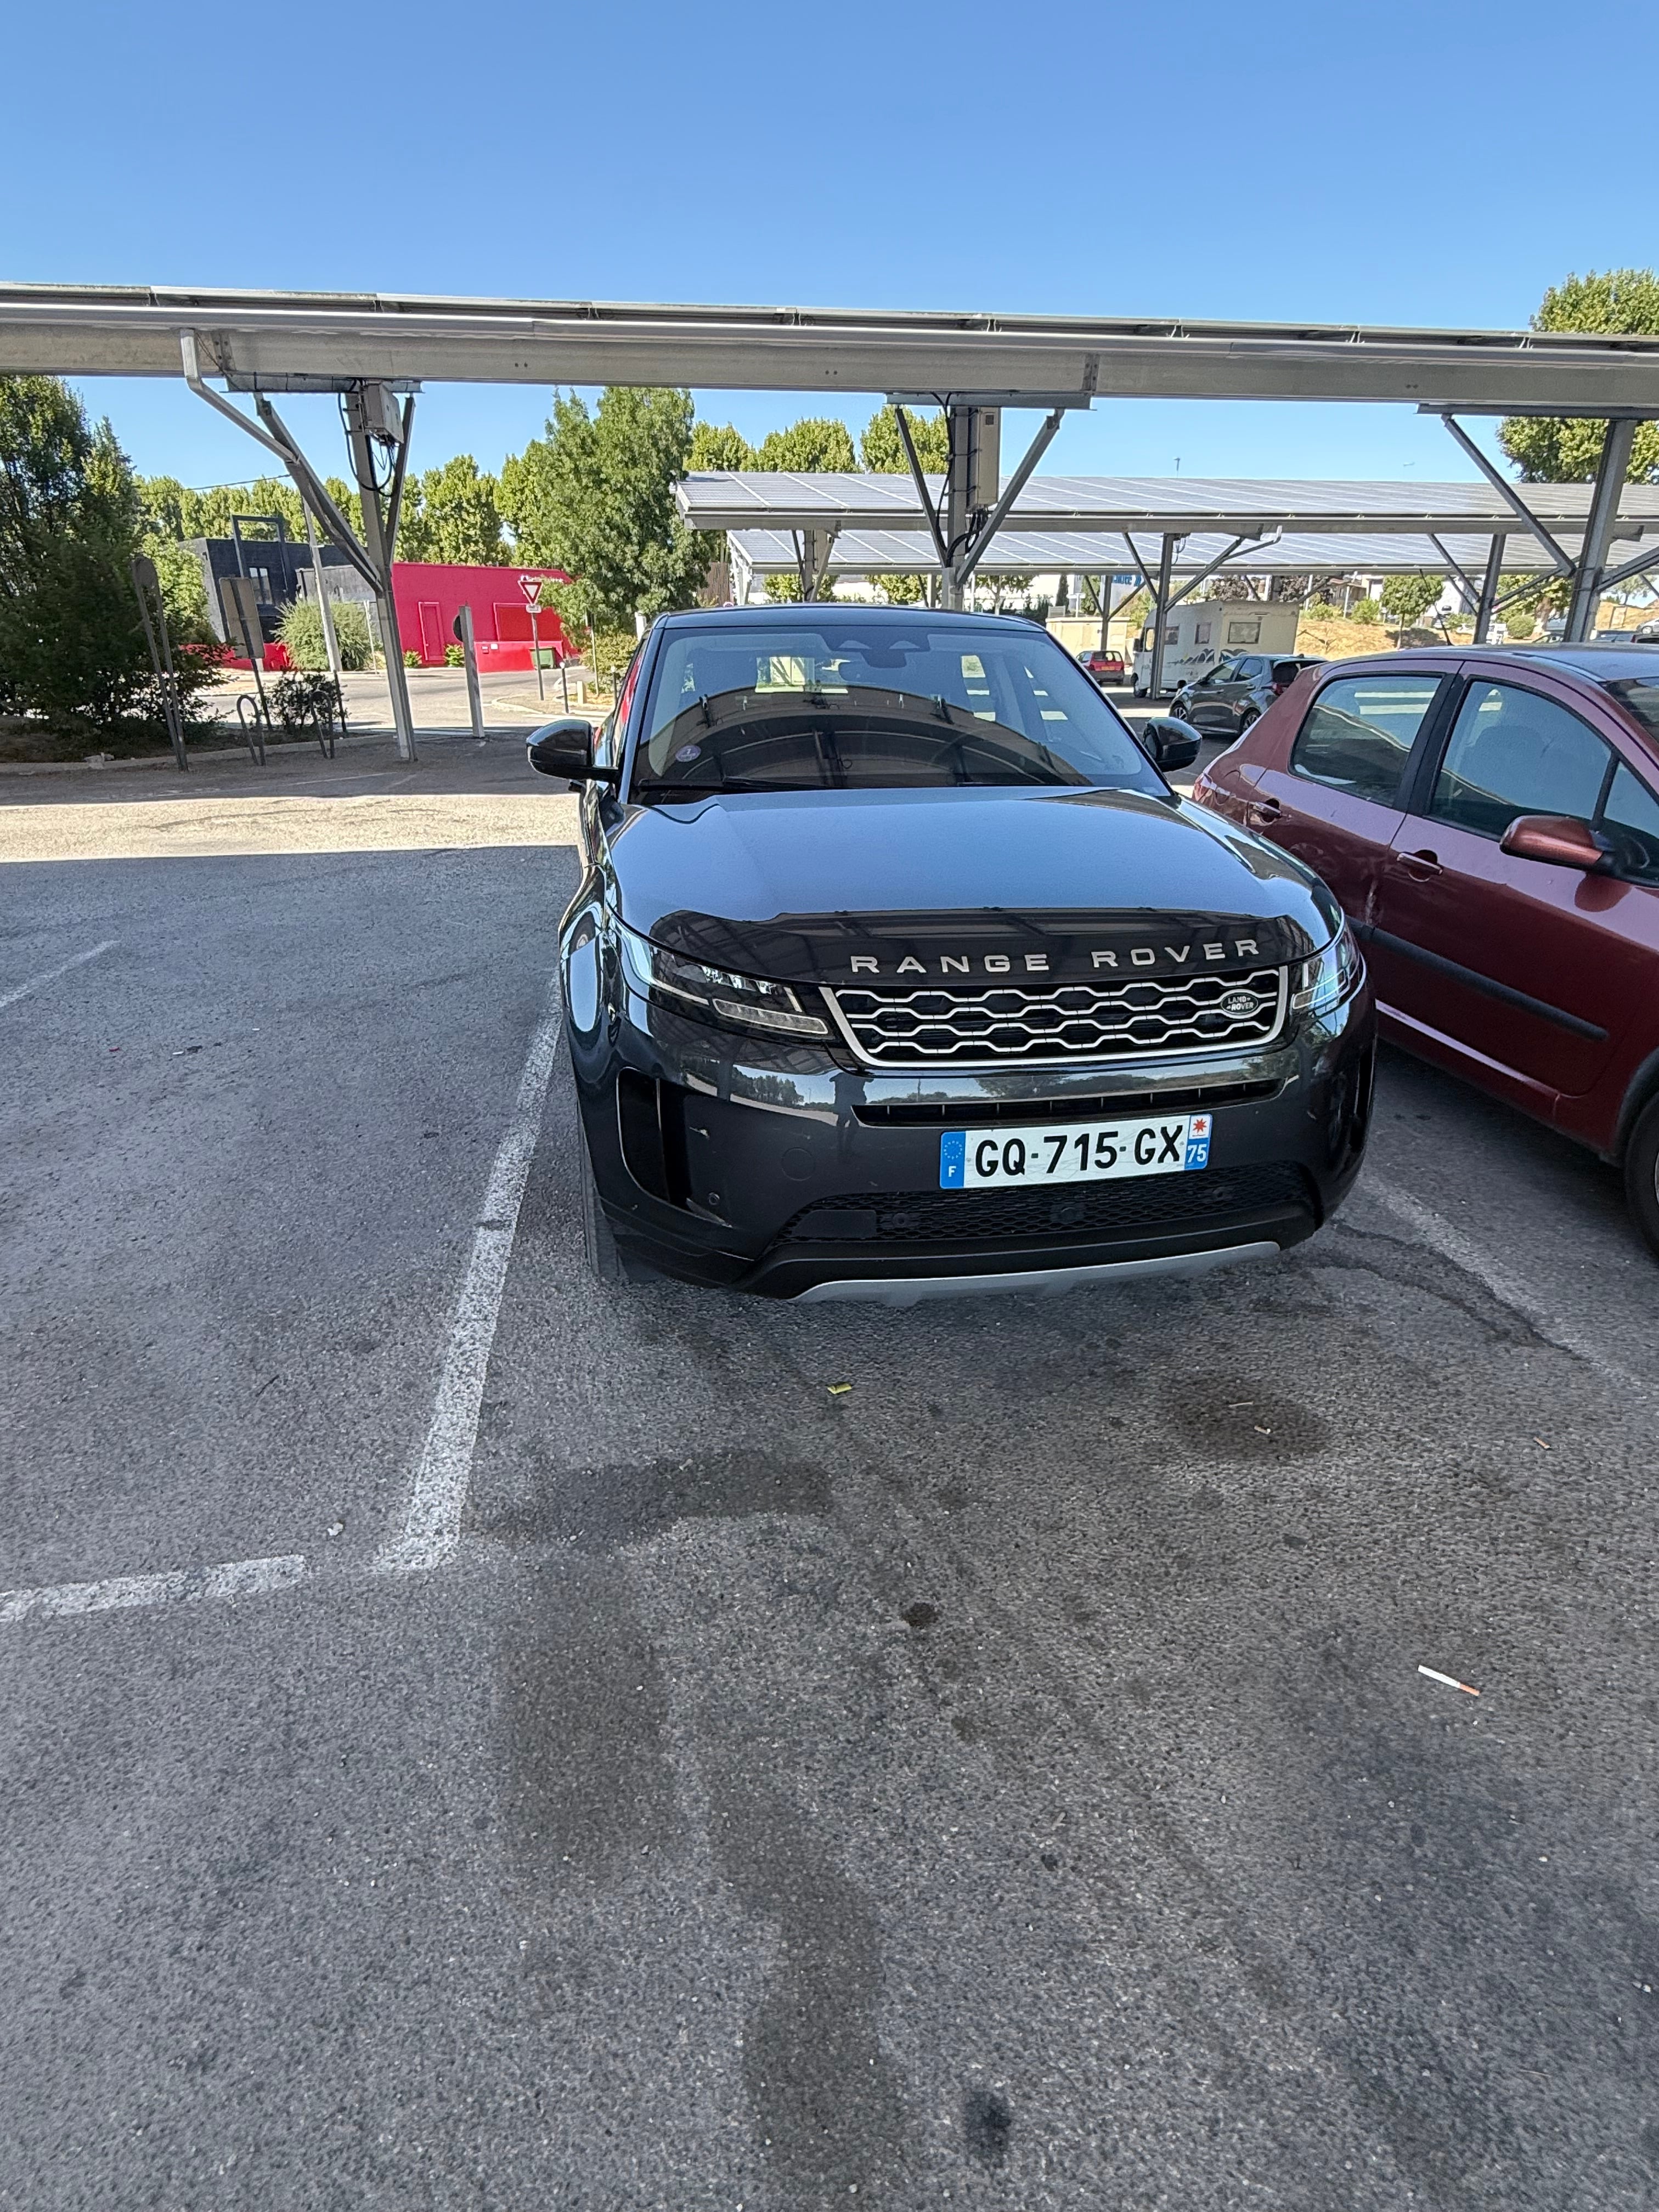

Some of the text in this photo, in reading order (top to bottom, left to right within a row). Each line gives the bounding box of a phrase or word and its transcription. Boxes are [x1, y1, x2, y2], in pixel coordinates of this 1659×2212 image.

[850, 939, 1260, 973] RANGE ROVER
[1228, 995, 1246, 1004] LAND
[1231, 1002, 1254, 1011] ROVER
[975, 1125, 1183, 1177] GQ-715-GX
[1187, 1143, 1207, 1164] 75
[947, 1165, 957, 1178] F
